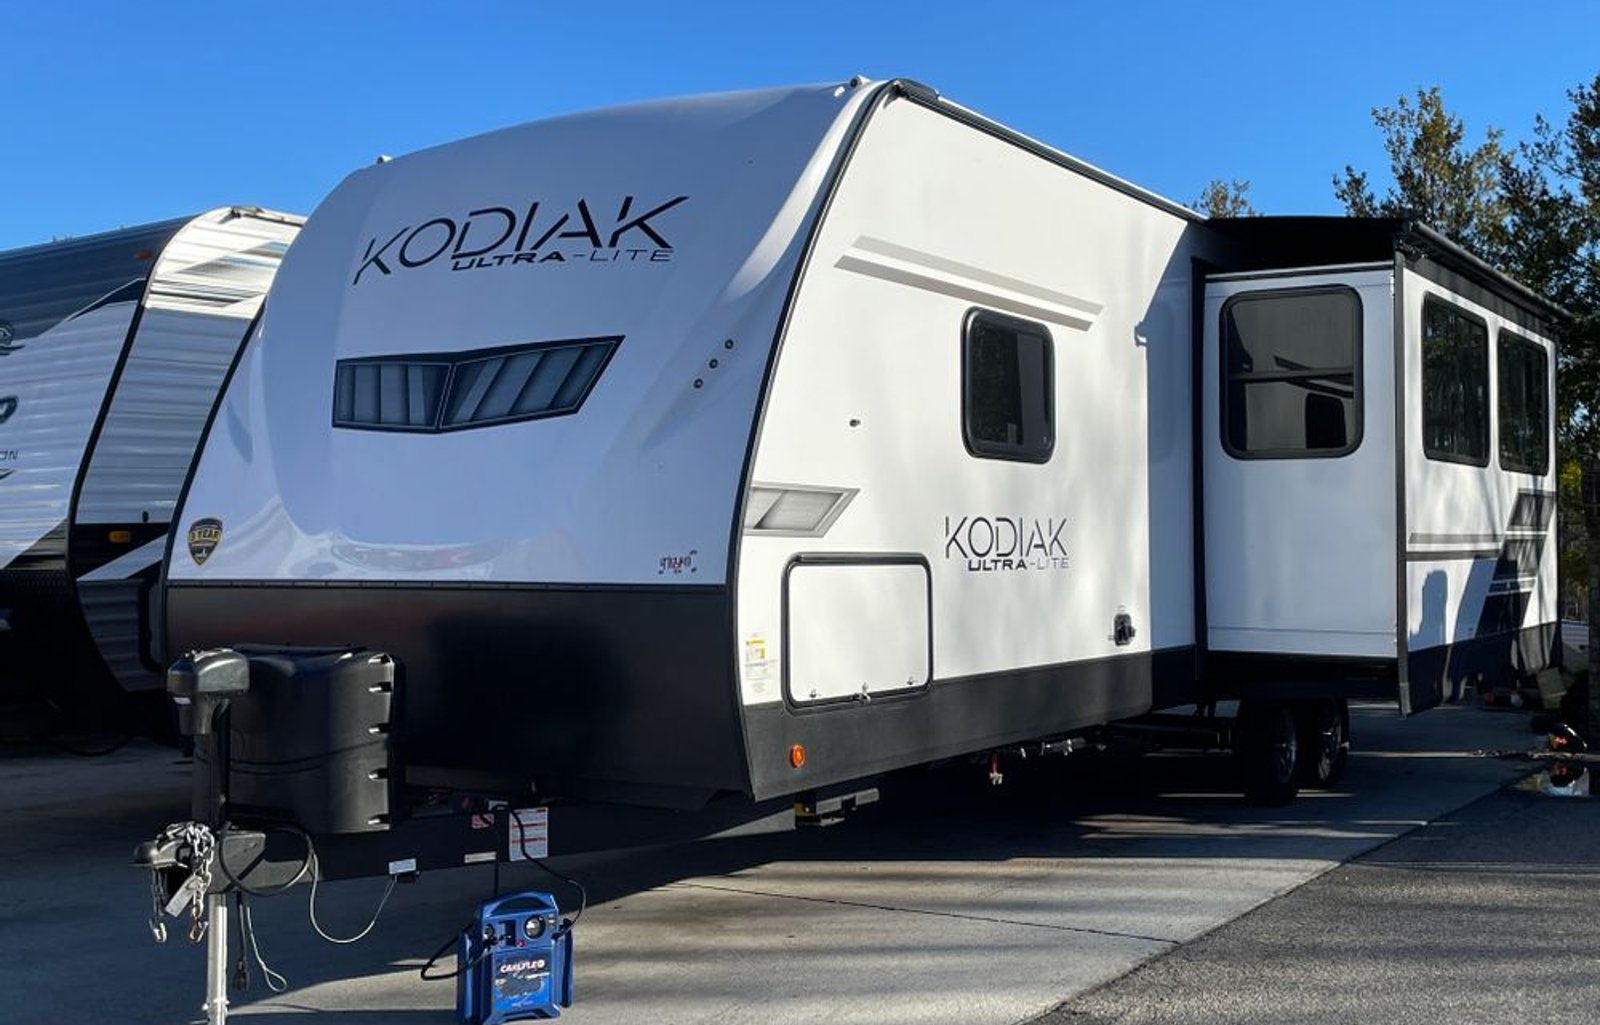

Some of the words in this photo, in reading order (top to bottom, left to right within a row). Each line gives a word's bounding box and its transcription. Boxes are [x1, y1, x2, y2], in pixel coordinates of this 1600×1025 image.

[353, 195, 690, 285] KODIAK
[452, 249, 675, 272] ULTRA-LITE
[945, 516, 1068, 559] KODIAK
[968, 558, 1069, 571] ULTRA-LITE
